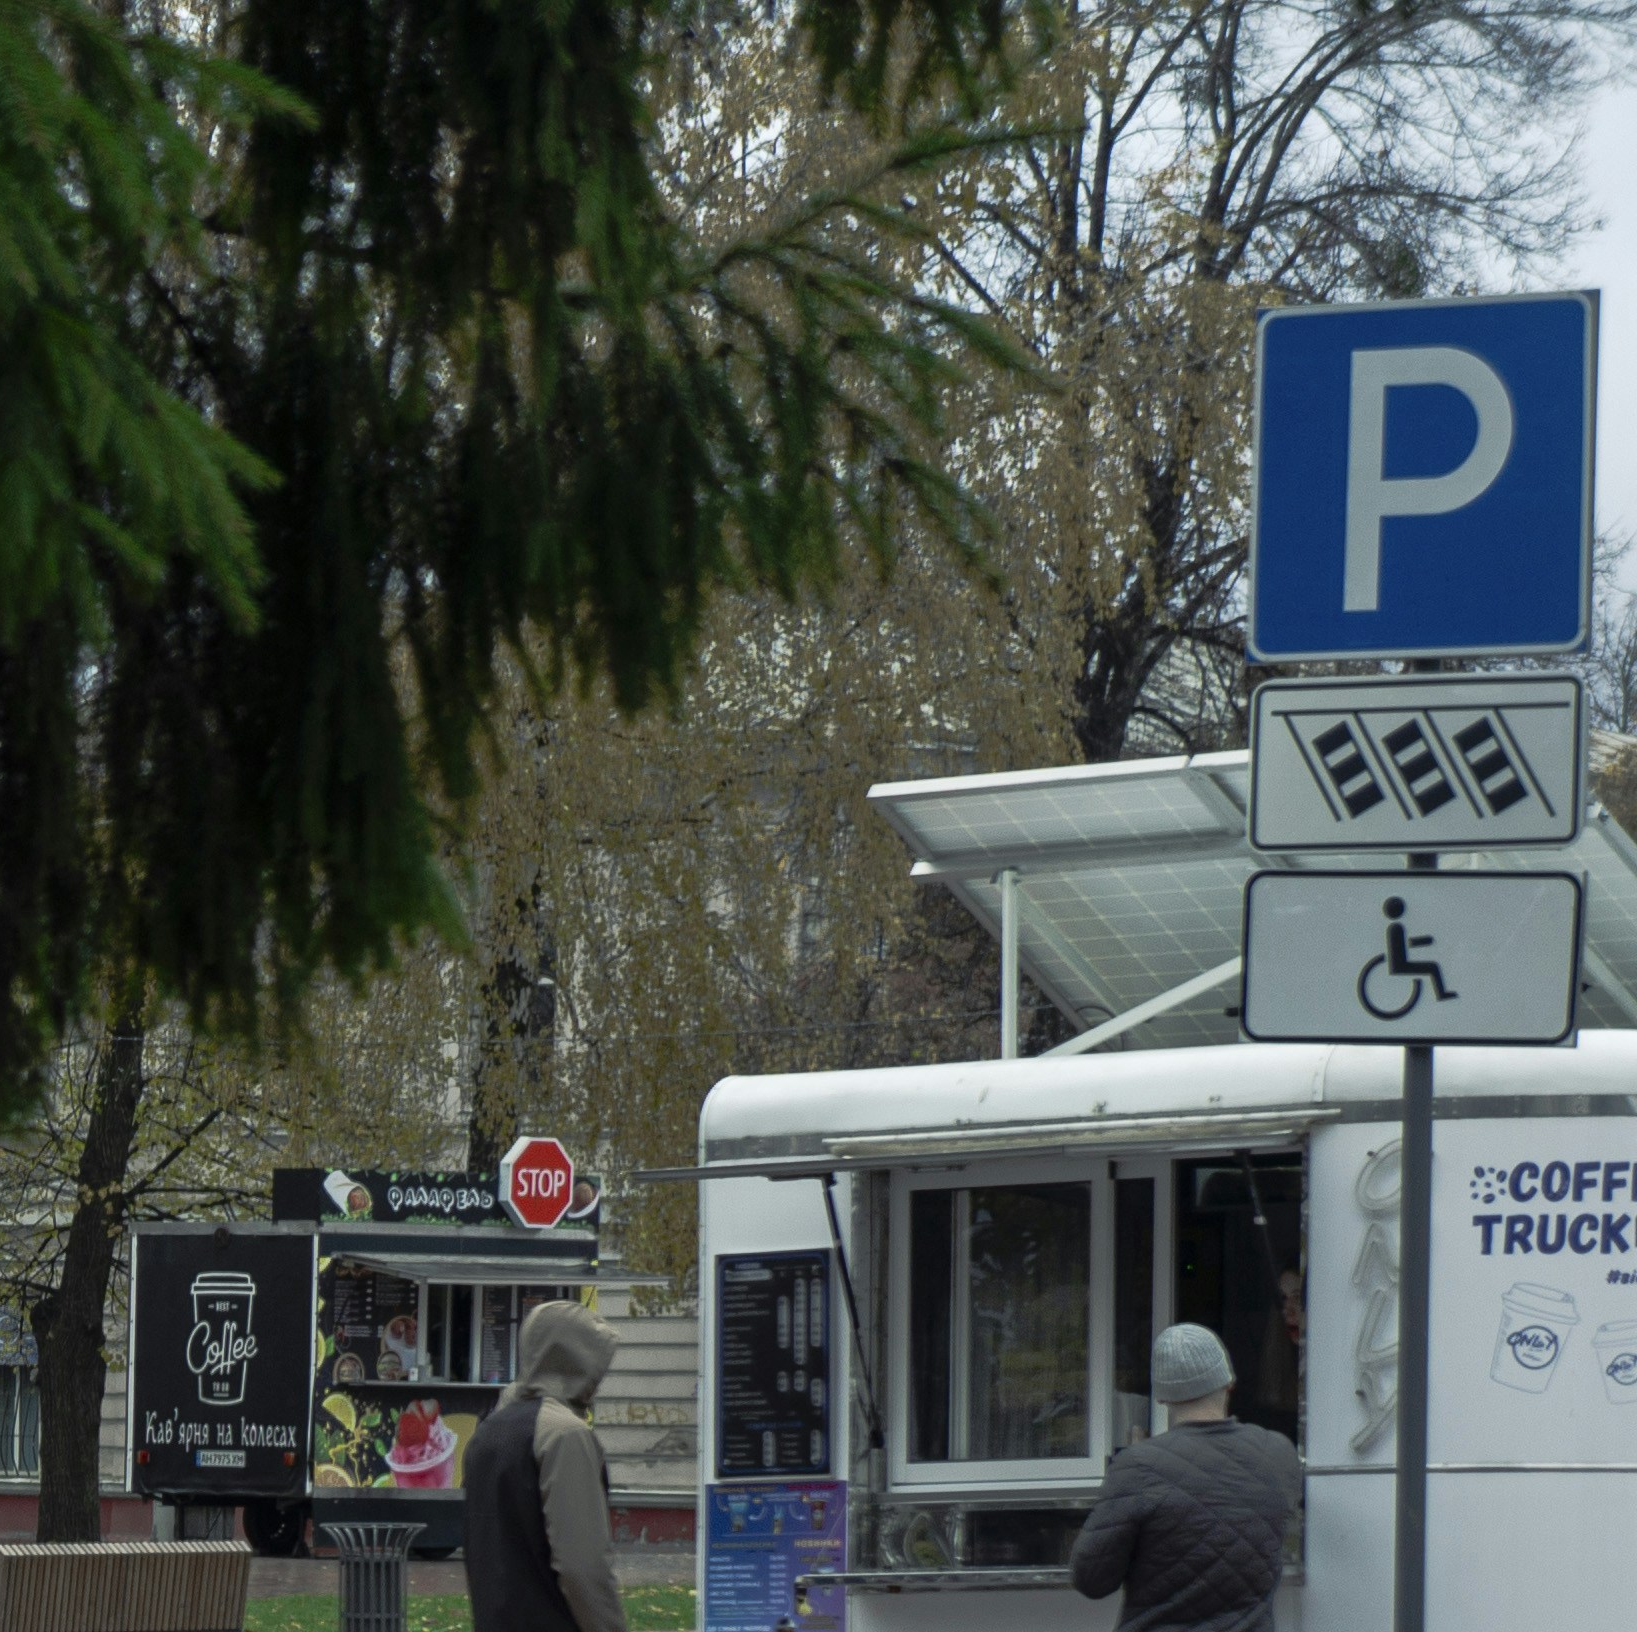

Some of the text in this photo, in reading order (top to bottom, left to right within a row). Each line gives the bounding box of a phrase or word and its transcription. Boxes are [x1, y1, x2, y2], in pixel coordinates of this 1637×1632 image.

[1343, 346, 1513, 613] P
[387, 1185, 495, 1213] ФАЛАФЕЛЬ
[516, 1168, 567, 1198] STOP
[1508, 1160, 1637, 1203] COFF
[1472, 1213, 1637, 1256] TRUCK
[186, 1319, 258, 1376] Coffee
[145, 1406, 297, 1453] Кав'ярня на колесах
